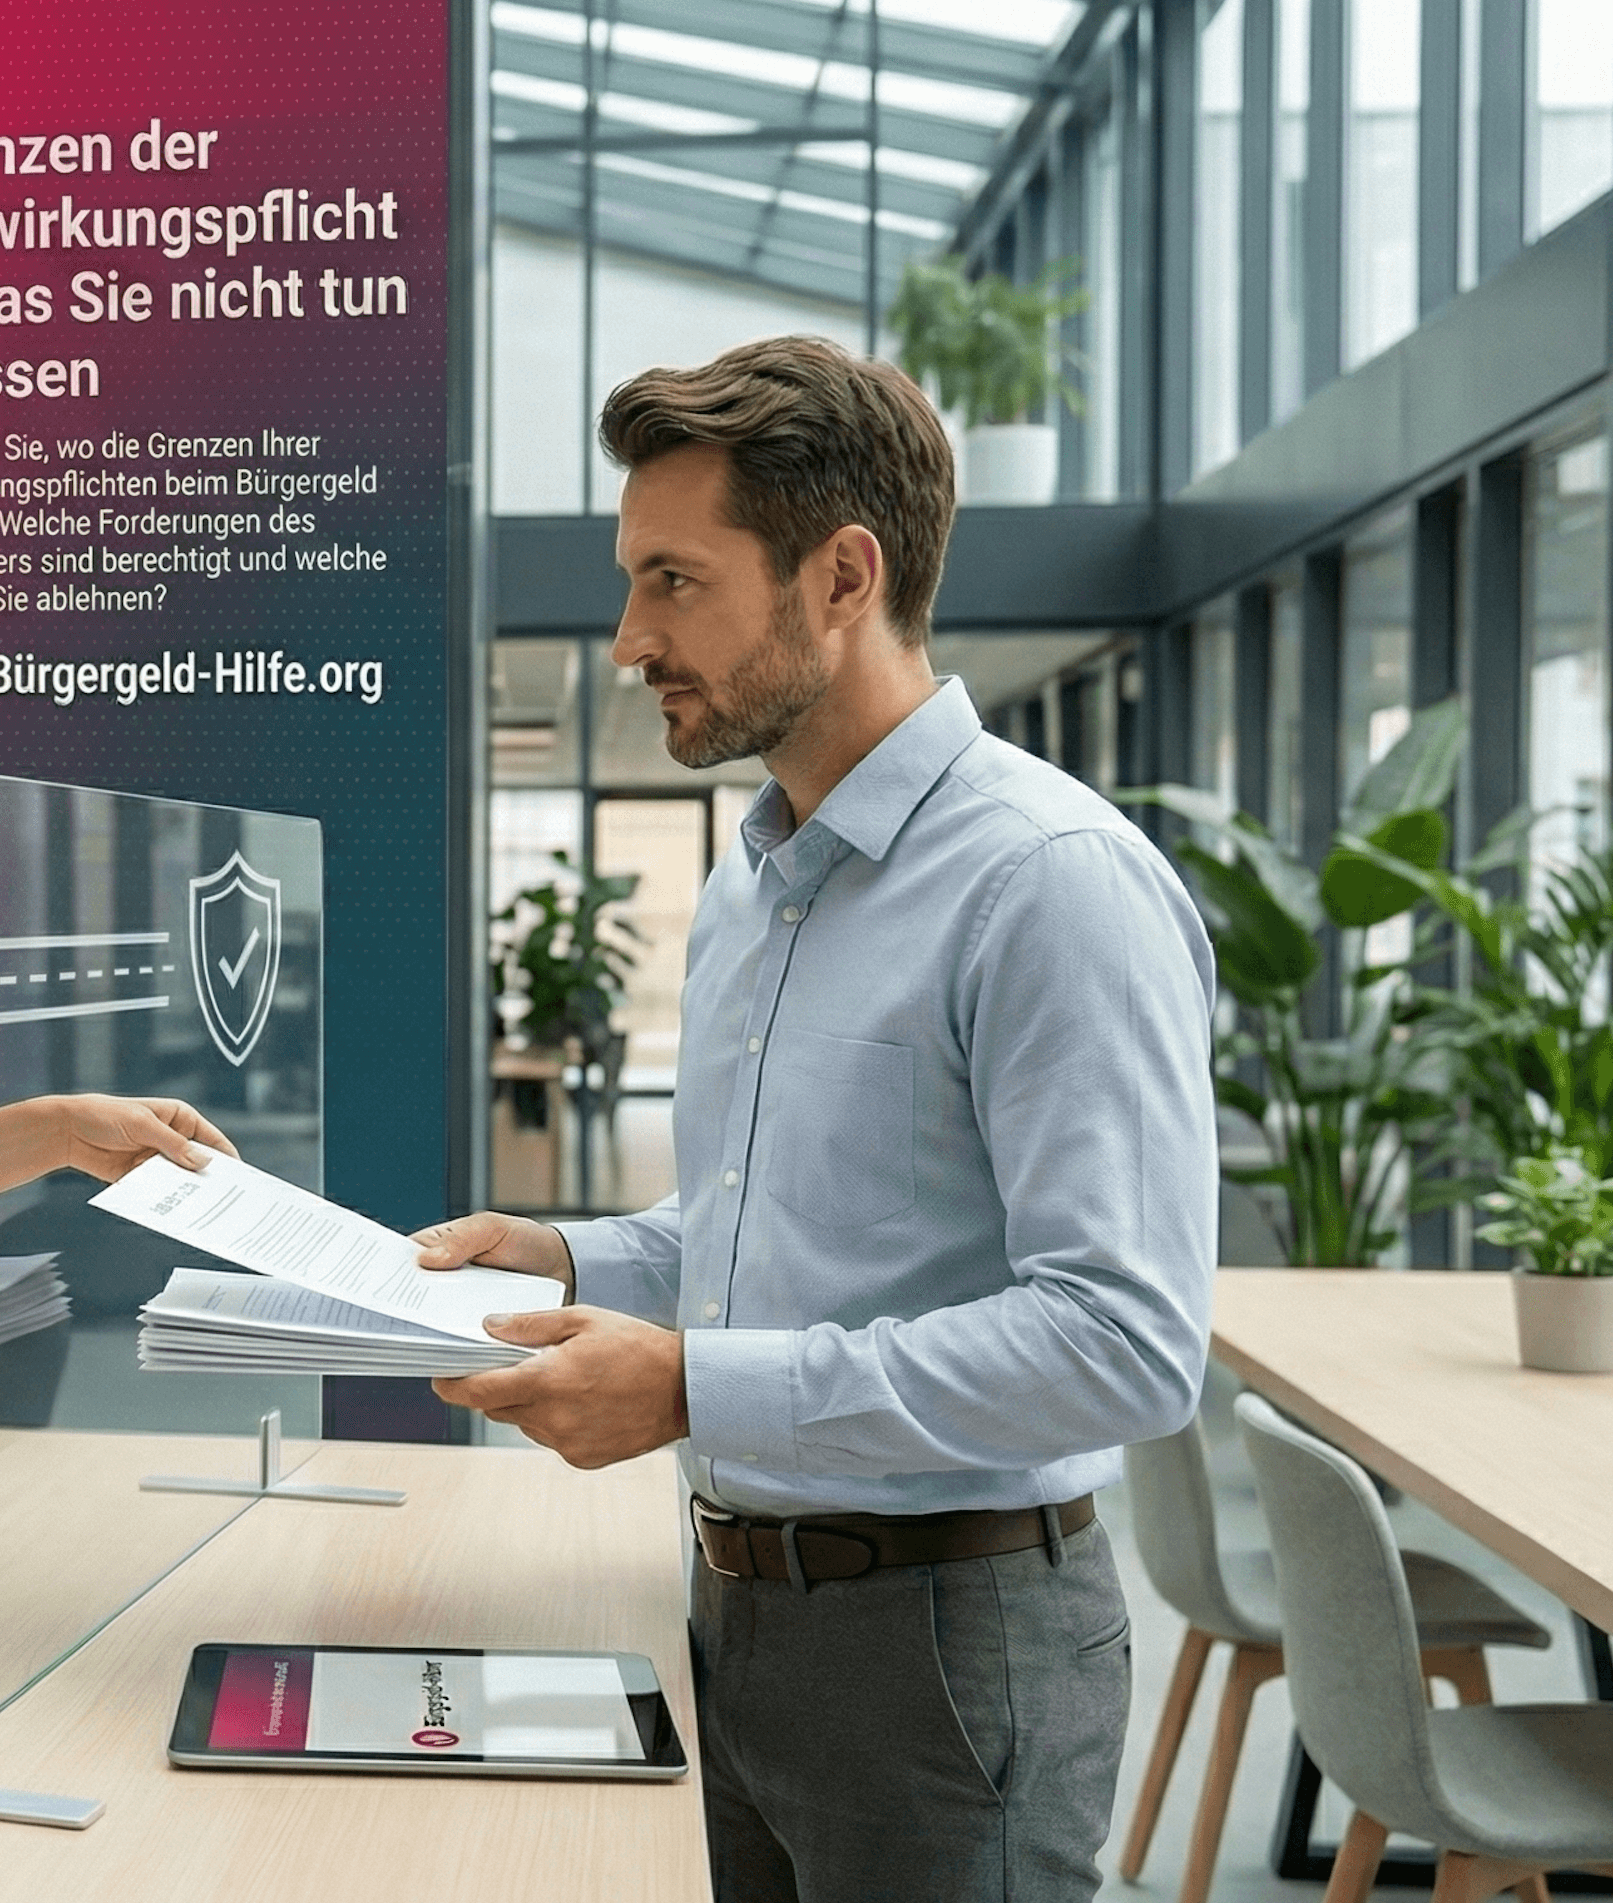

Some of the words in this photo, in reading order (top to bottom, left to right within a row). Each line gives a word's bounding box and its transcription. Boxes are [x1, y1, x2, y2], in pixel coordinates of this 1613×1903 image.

[130, 117, 219, 172] der
[69, 269, 153, 323] Sie
[171, 265, 305, 320] nicht
[318, 268, 407, 317] tun
[4, 433, 49, 464] Sie,
[56, 438, 95, 460] wo
[101, 430, 140, 459] die
[147, 432, 253, 459] Grenzen
[263, 427, 321, 457] Ihrer
[165, 468, 228, 496] beim
[236, 464, 377, 502] Bürgergeld
[99, 506, 261, 541] Forderungen
[269, 505, 315, 534] des
[40, 545, 94, 574] sind
[102, 544, 232, 579] berechtigt
[239, 543, 287, 572] und
[294, 542, 387, 571] welche
[36, 583, 167, 612] ablehnen?
